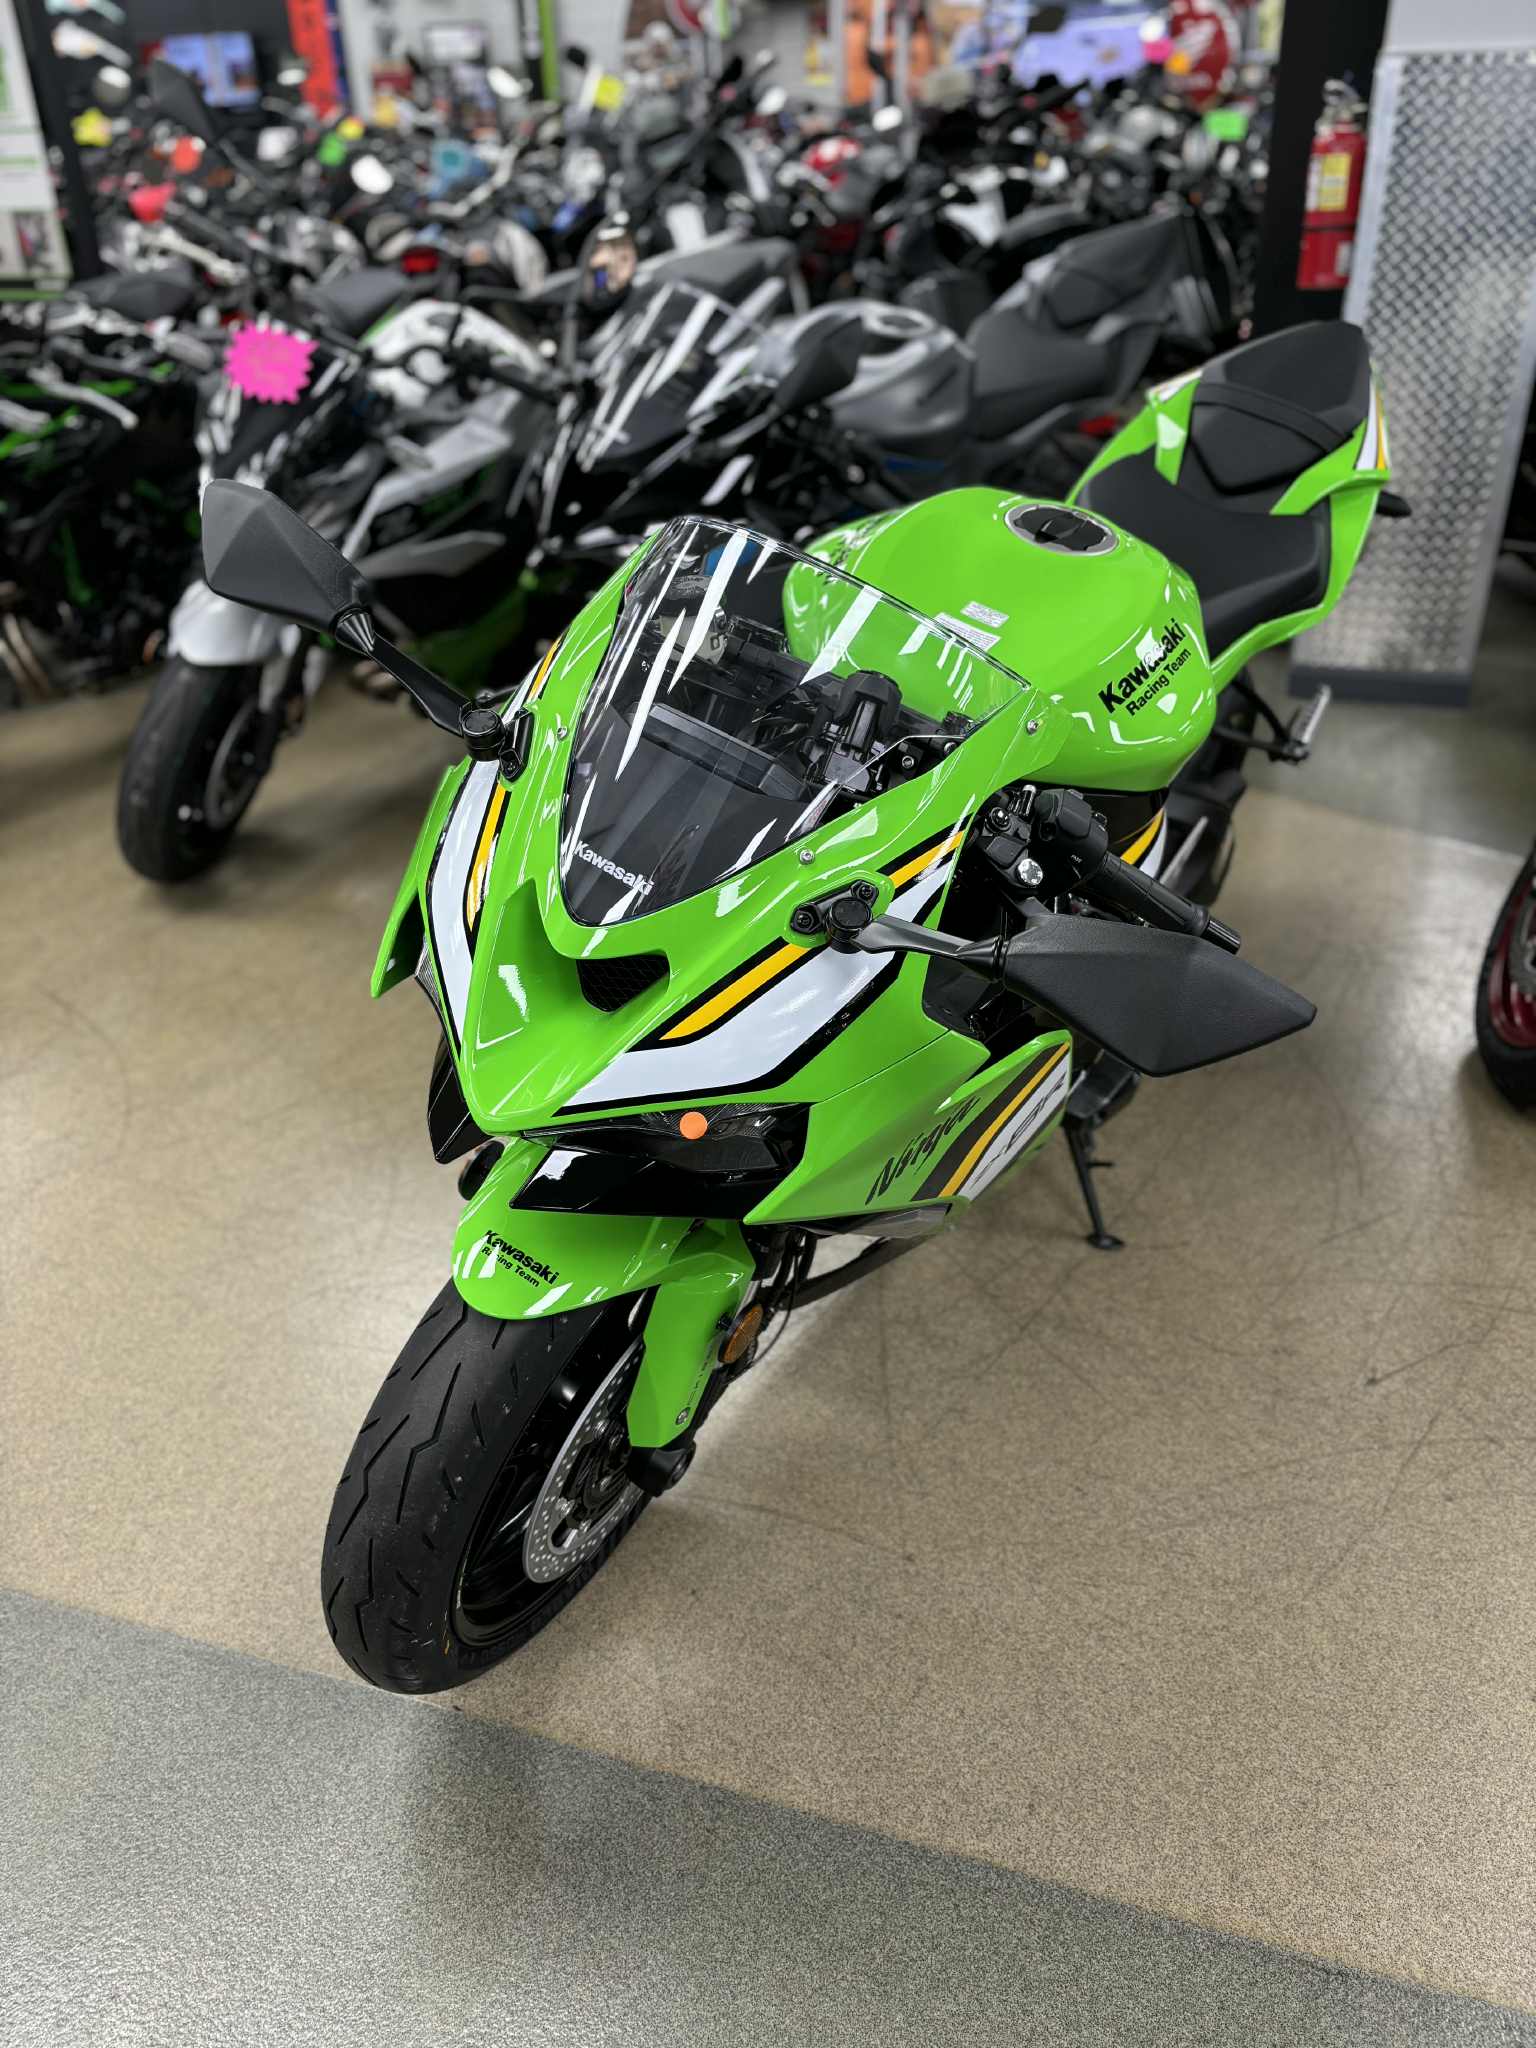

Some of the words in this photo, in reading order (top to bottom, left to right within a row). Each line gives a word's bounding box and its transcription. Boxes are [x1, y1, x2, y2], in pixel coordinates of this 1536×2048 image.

[1098, 618, 1186, 713] Kawasaki
[1126, 673, 1170, 716] Racing
[1164, 649, 1191, 676] Team
[574, 841, 655, 895] Kawasaki
[865, 1095, 981, 1205] Ninja
[481, 1246, 513, 1270] Raing
[514, 1265, 540, 1287] Team
[485, 1229, 560, 1284] Kawasaki
